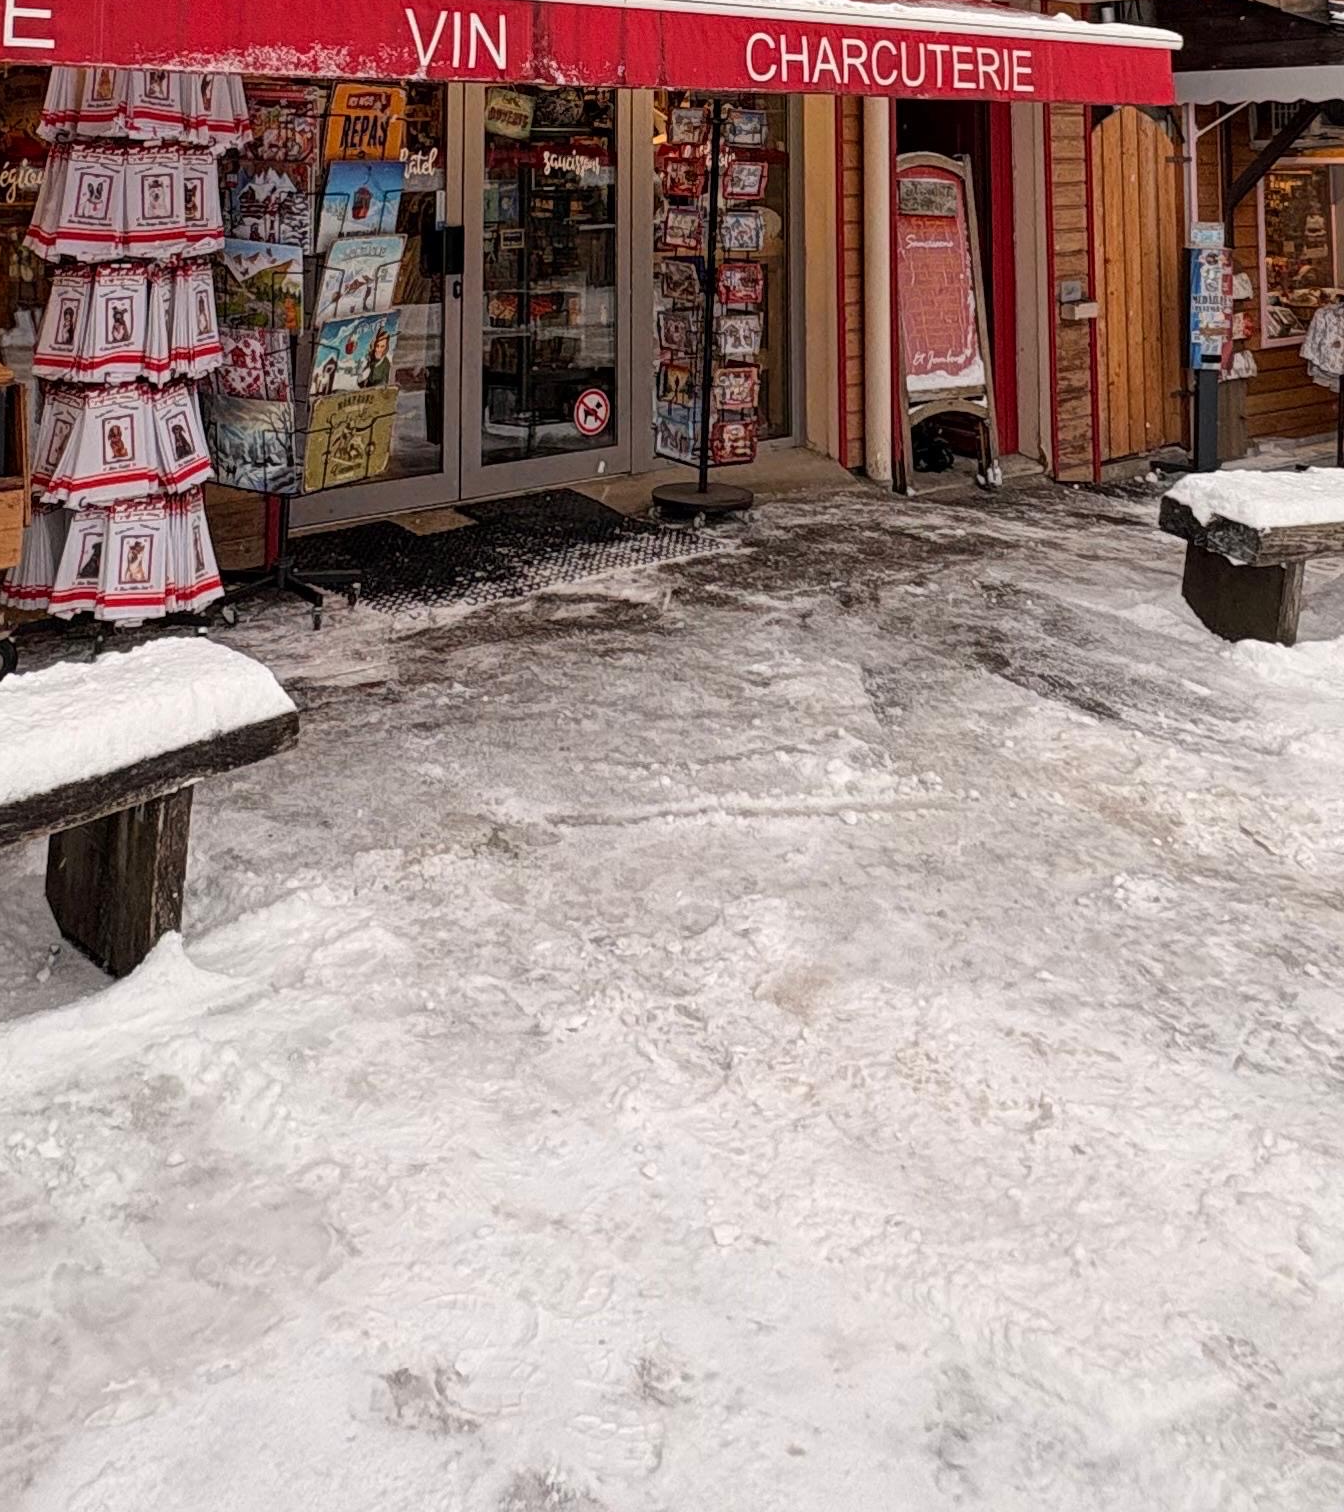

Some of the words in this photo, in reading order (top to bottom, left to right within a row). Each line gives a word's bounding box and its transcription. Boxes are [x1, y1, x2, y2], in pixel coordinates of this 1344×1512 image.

[405, 7, 507, 72] VIN
[745, 31, 1035, 93] CHARCUTERIE
[340, 115, 389, 148] REPAS
